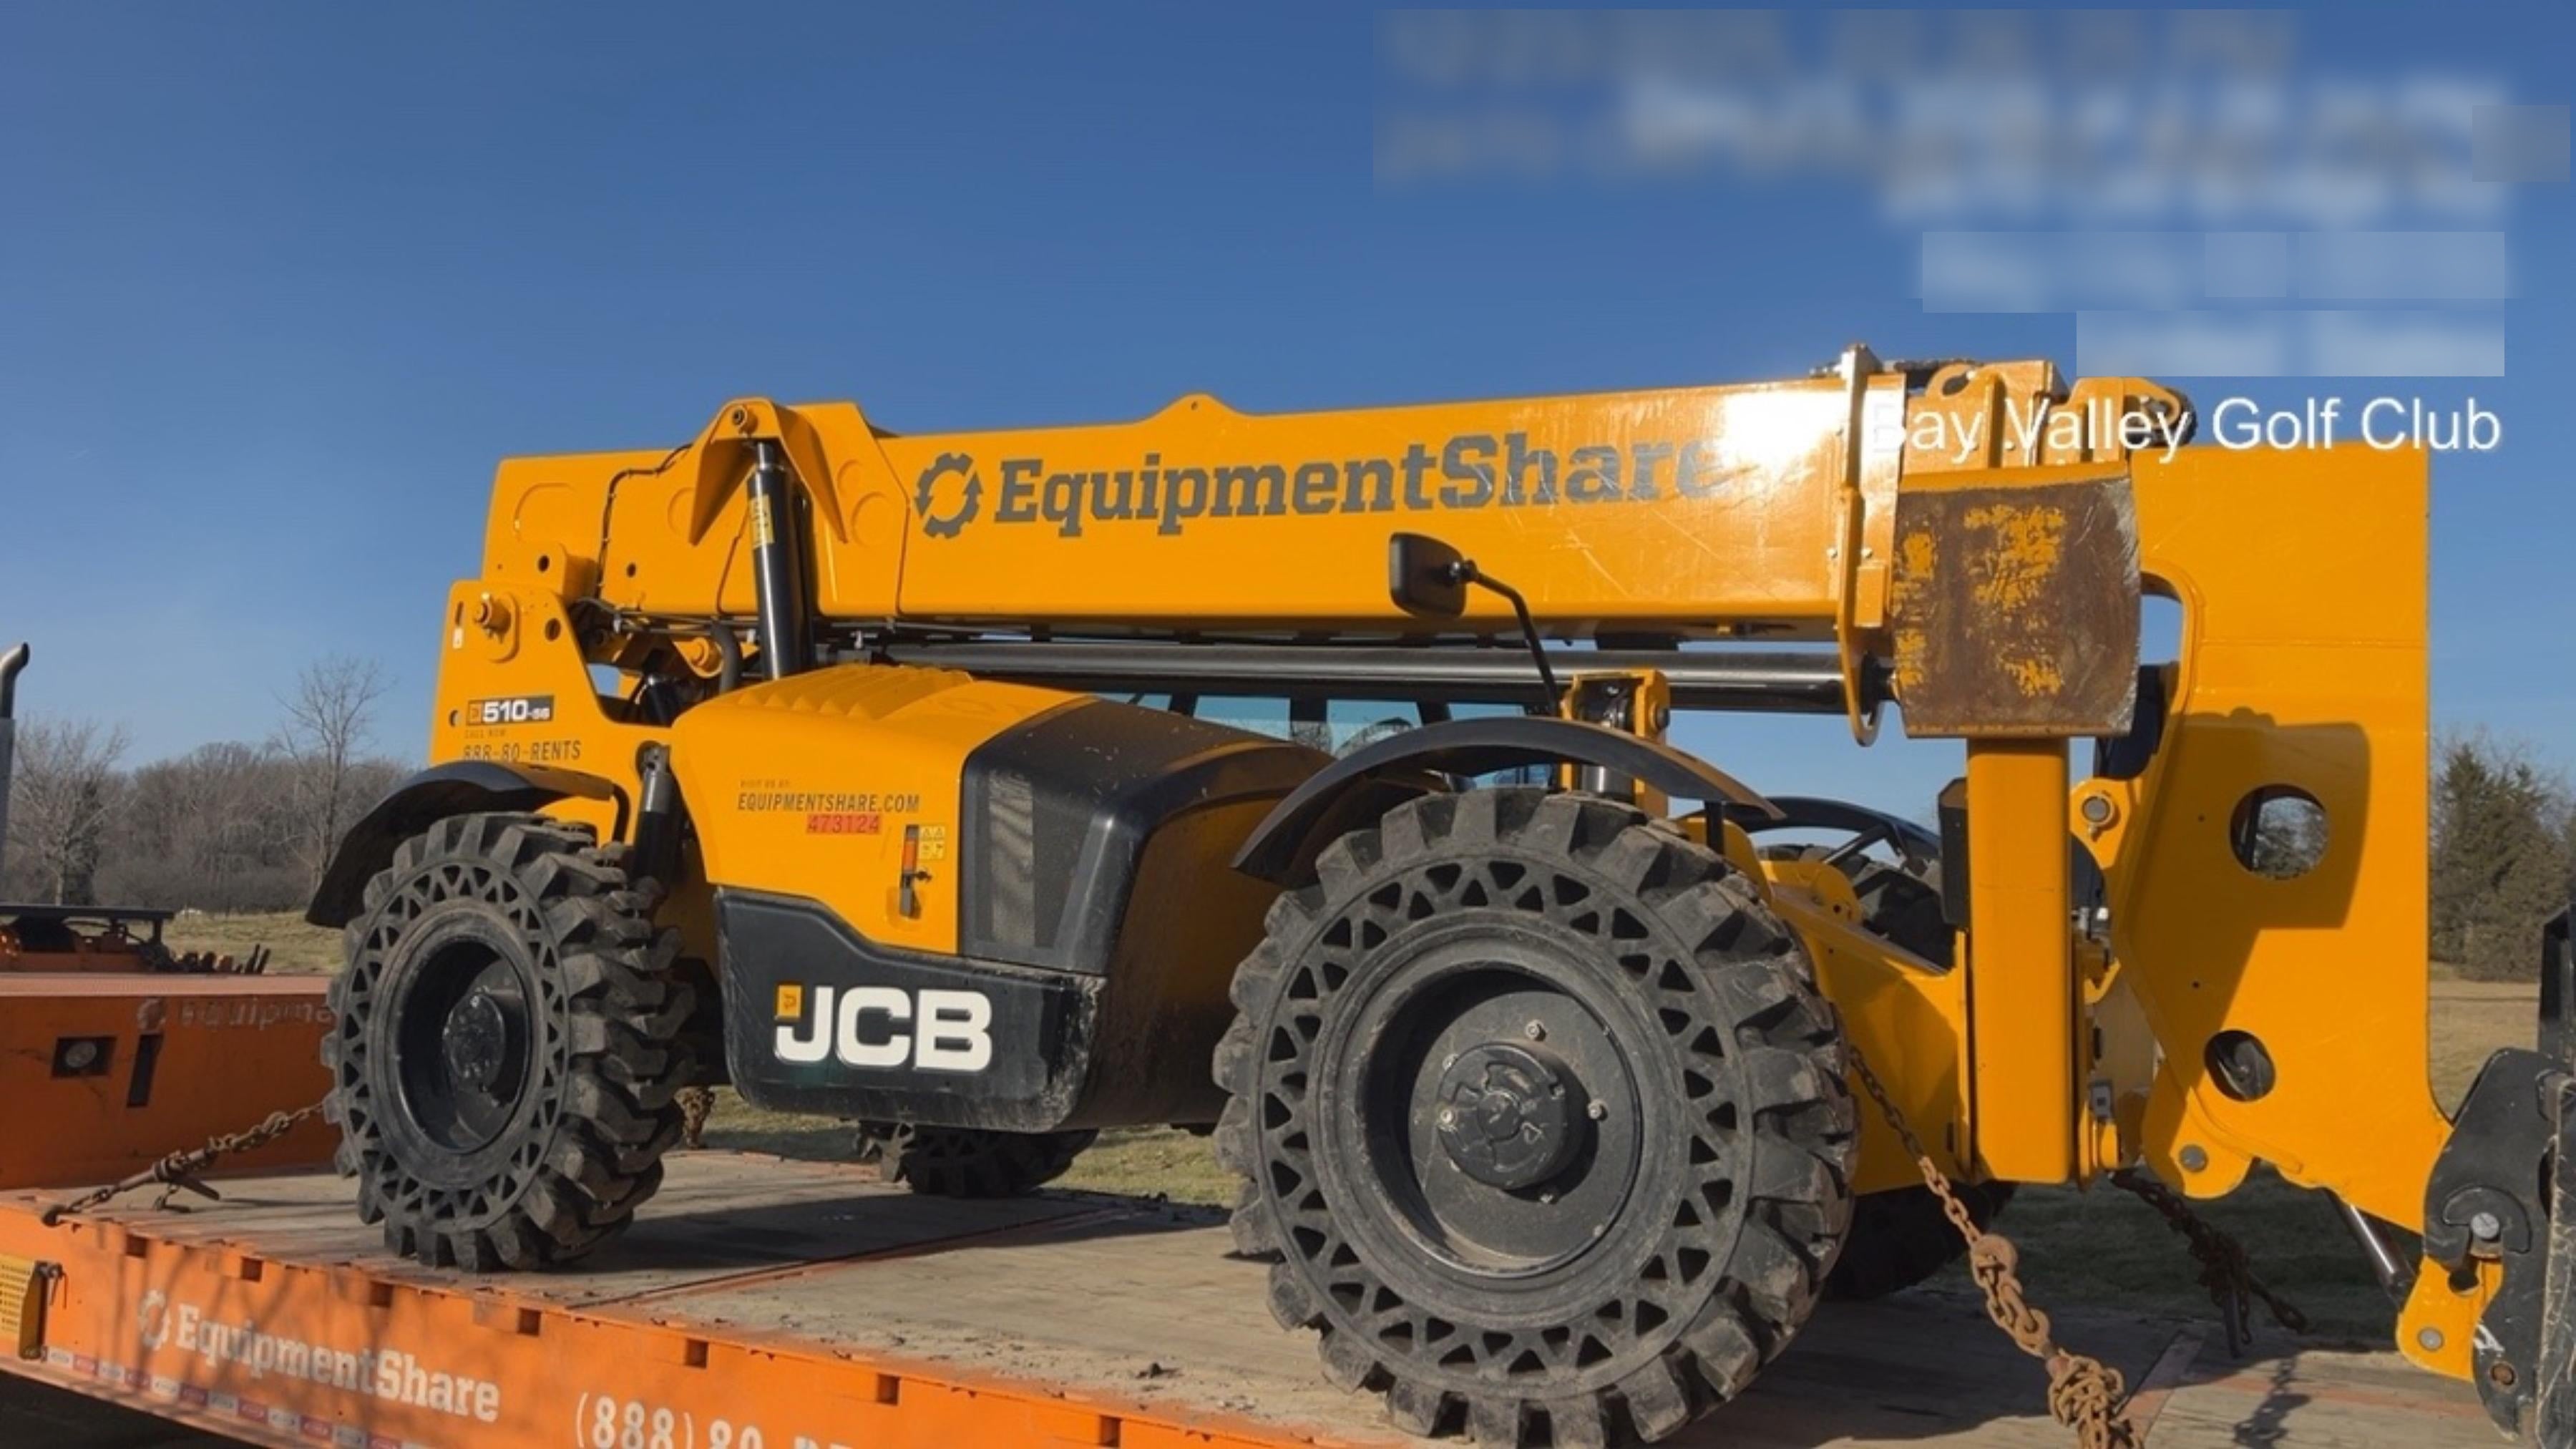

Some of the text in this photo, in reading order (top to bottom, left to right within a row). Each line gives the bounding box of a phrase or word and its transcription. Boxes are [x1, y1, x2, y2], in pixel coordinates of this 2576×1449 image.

[994, 431, 1735, 538] EquipmentShare
[738, 793, 919, 813] EQUIPMENTSHARE.COM
[807, 814, 881, 834] 473124
[774, 985, 992, 1072] JCB
[176, 1302, 499, 1423] EquipmentShare
